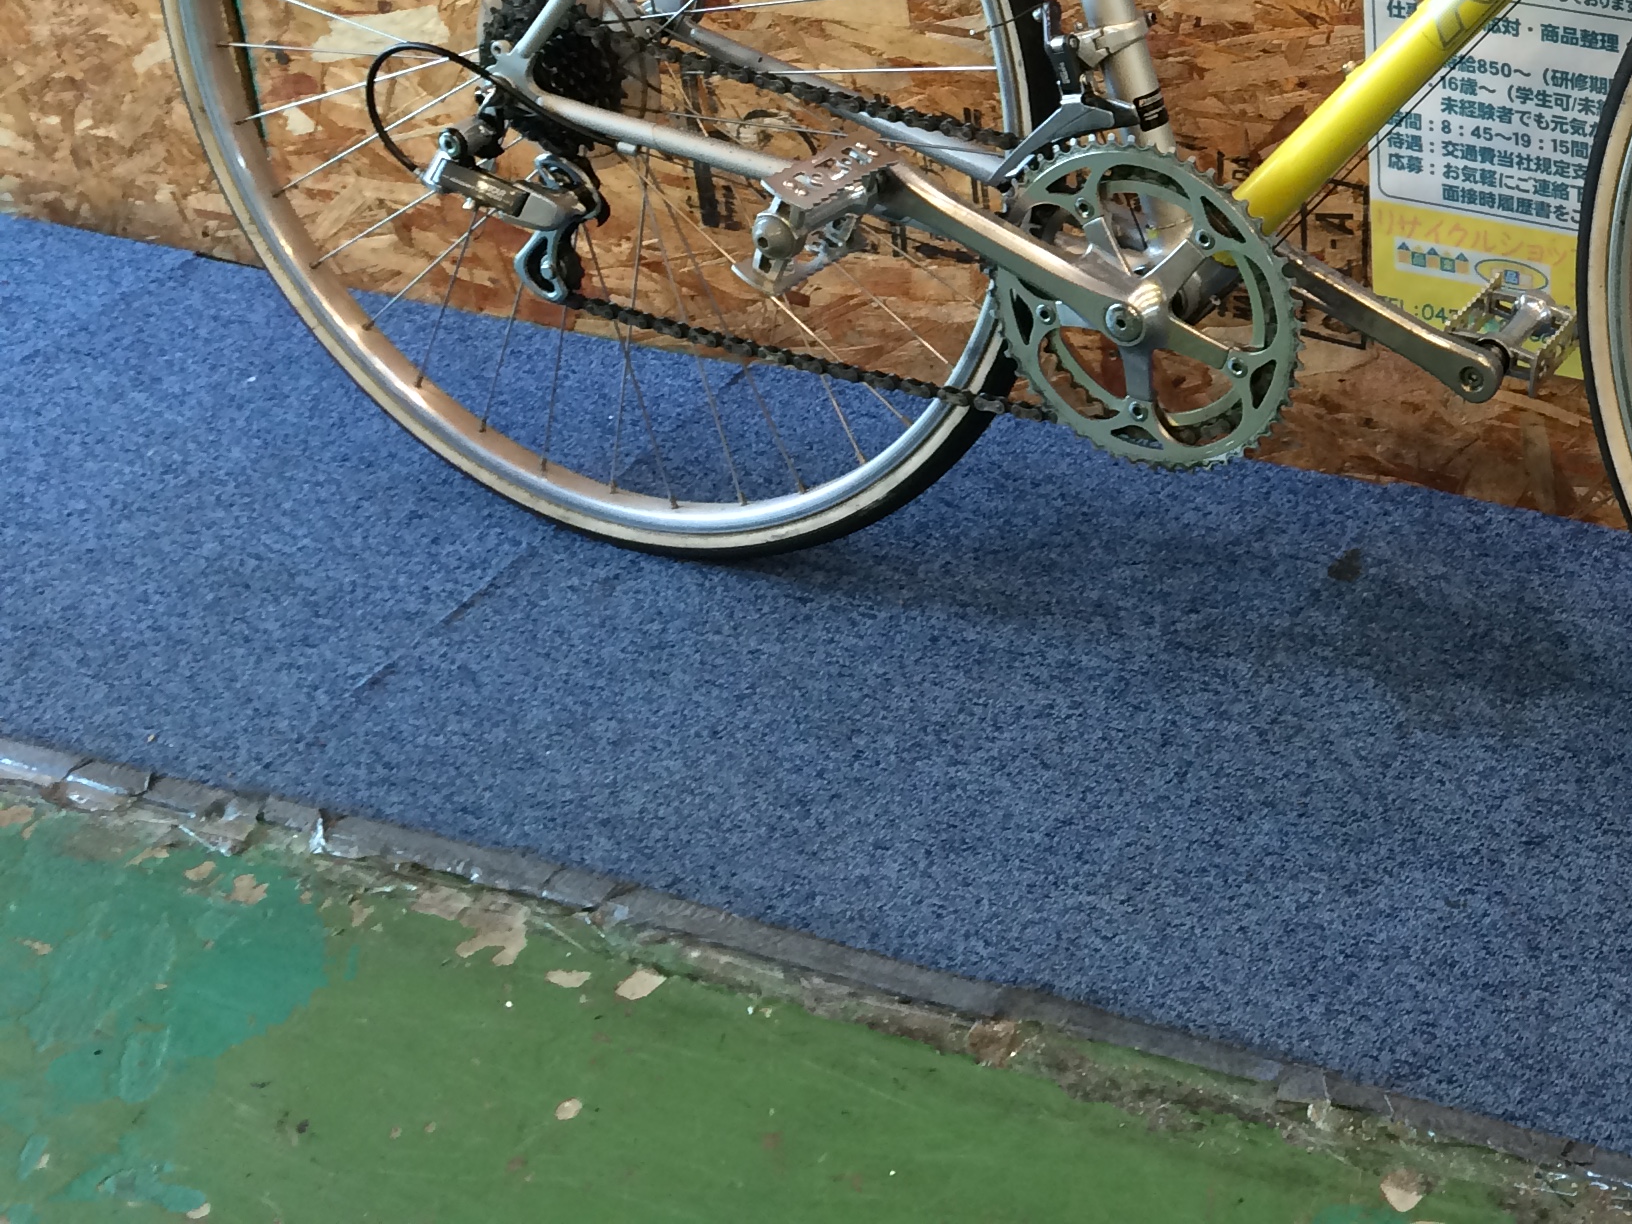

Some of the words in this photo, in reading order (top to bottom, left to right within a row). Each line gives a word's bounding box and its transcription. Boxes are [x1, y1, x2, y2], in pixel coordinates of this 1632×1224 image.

[1376, 207, 1575, 266] リサイクルショッ
